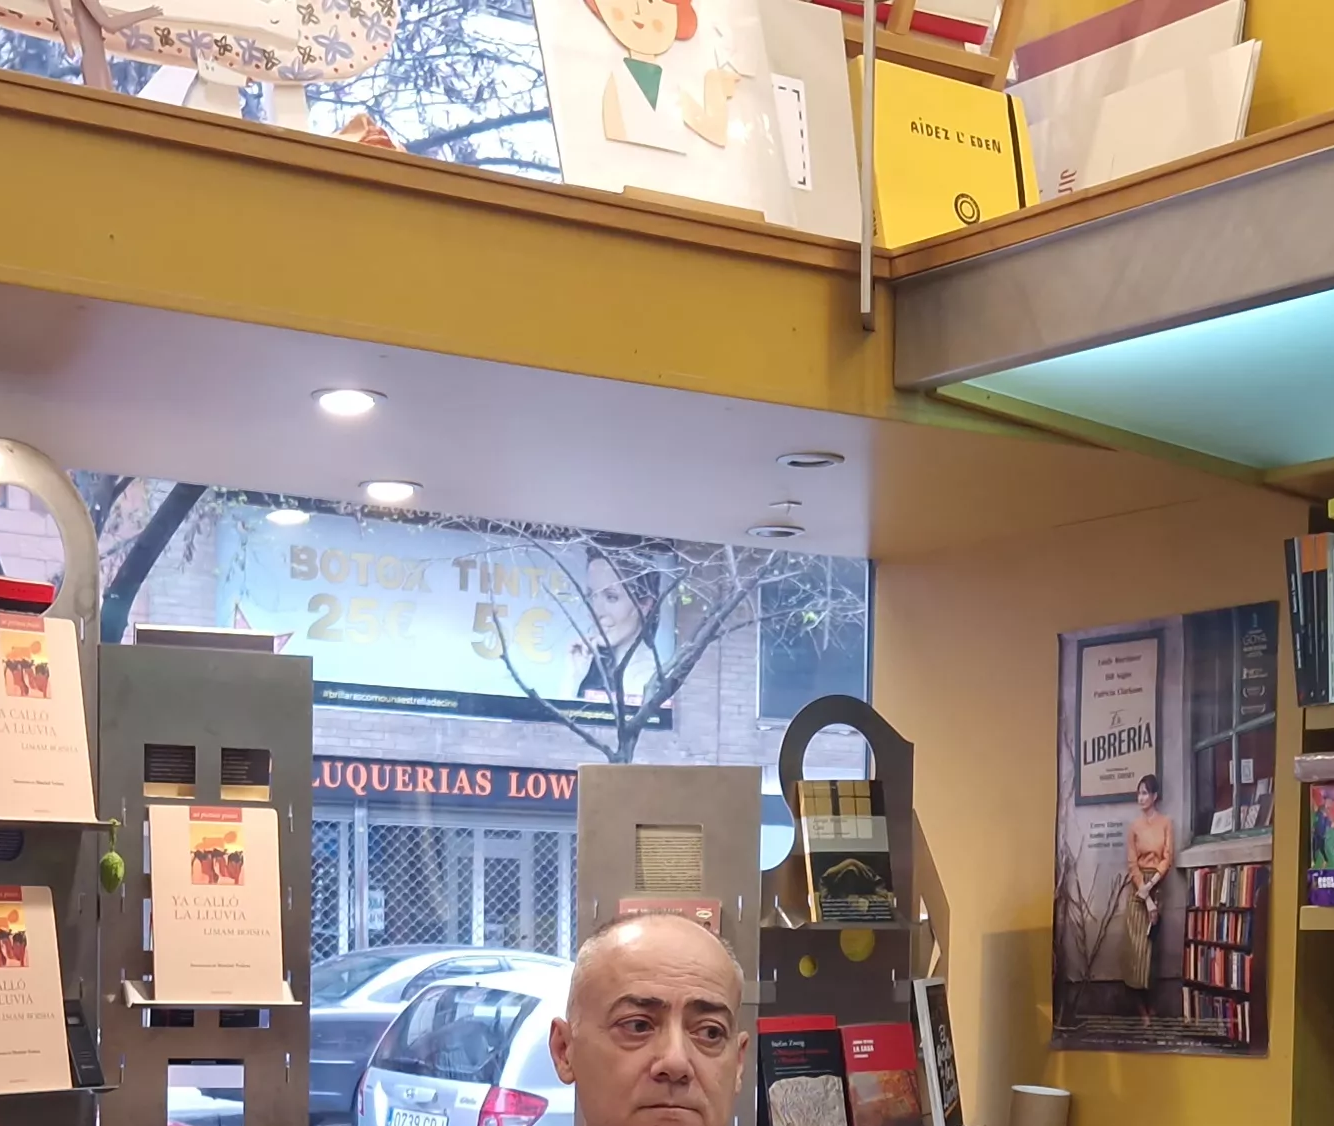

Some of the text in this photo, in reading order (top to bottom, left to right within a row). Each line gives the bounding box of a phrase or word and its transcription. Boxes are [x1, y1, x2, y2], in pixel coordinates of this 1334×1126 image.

[970, 135, 1002, 154] EDEN
[289, 545, 569, 598] BOTOX TINTE
[470, 602, 553, 663] 5€
[1083, 717, 1153, 766] LIBRERÍA
[508, 771, 577, 800] LOW
[171, 893, 239, 908] YA CALLÓ
[174, 908, 247, 923] LA LLUVIA
